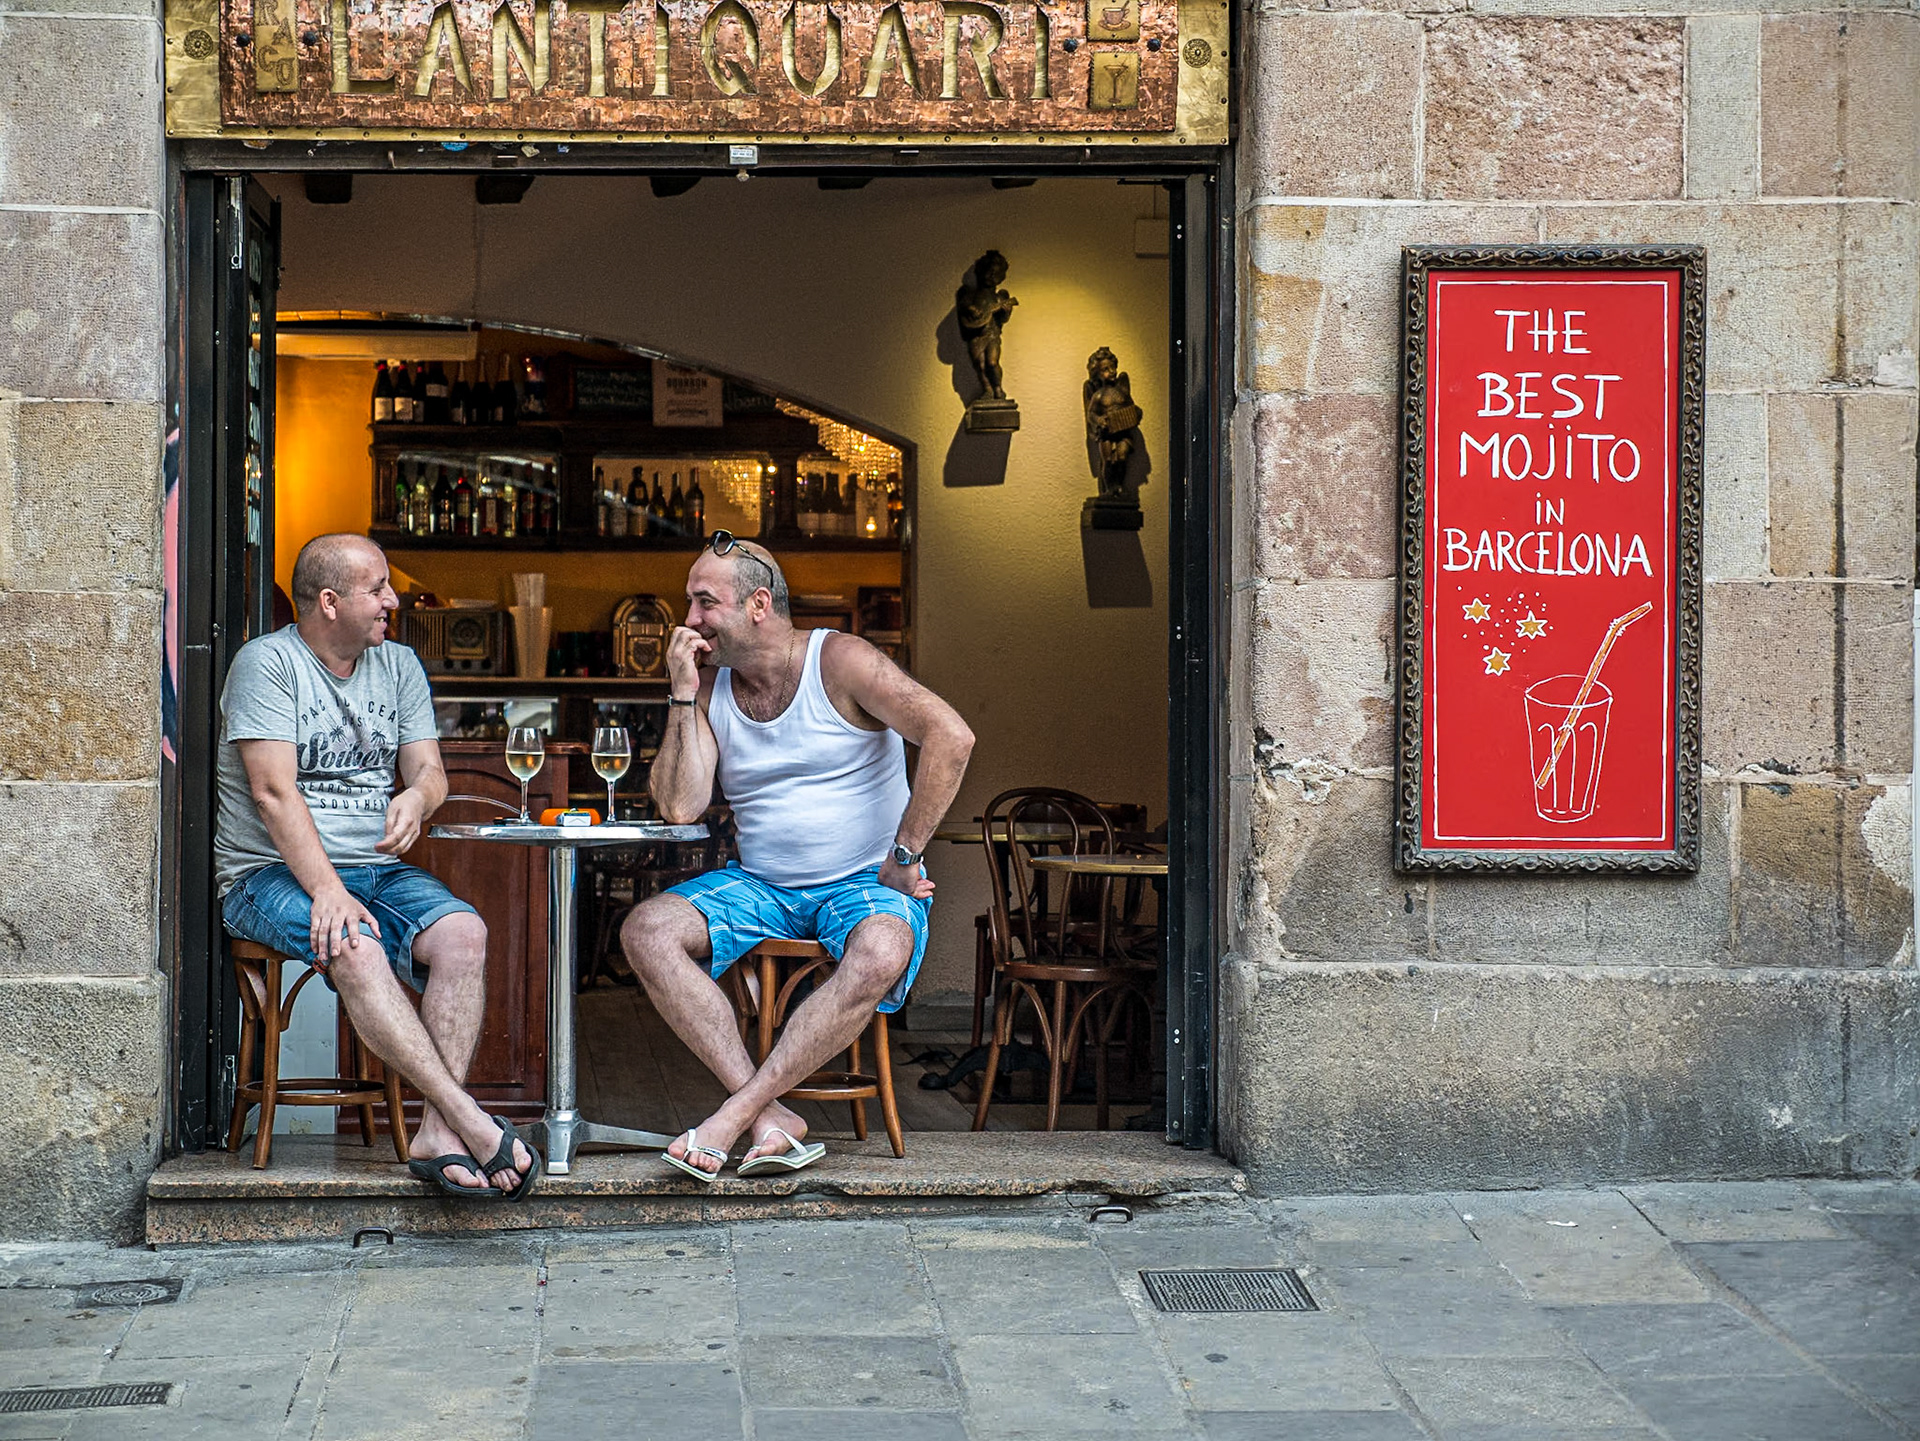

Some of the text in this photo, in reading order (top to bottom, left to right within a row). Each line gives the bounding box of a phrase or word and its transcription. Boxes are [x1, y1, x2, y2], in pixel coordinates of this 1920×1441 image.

[1494, 308, 1592, 354] THE
[1477, 372, 1623, 420] BEST
[1443, 527, 1654, 577] BARCELONA
